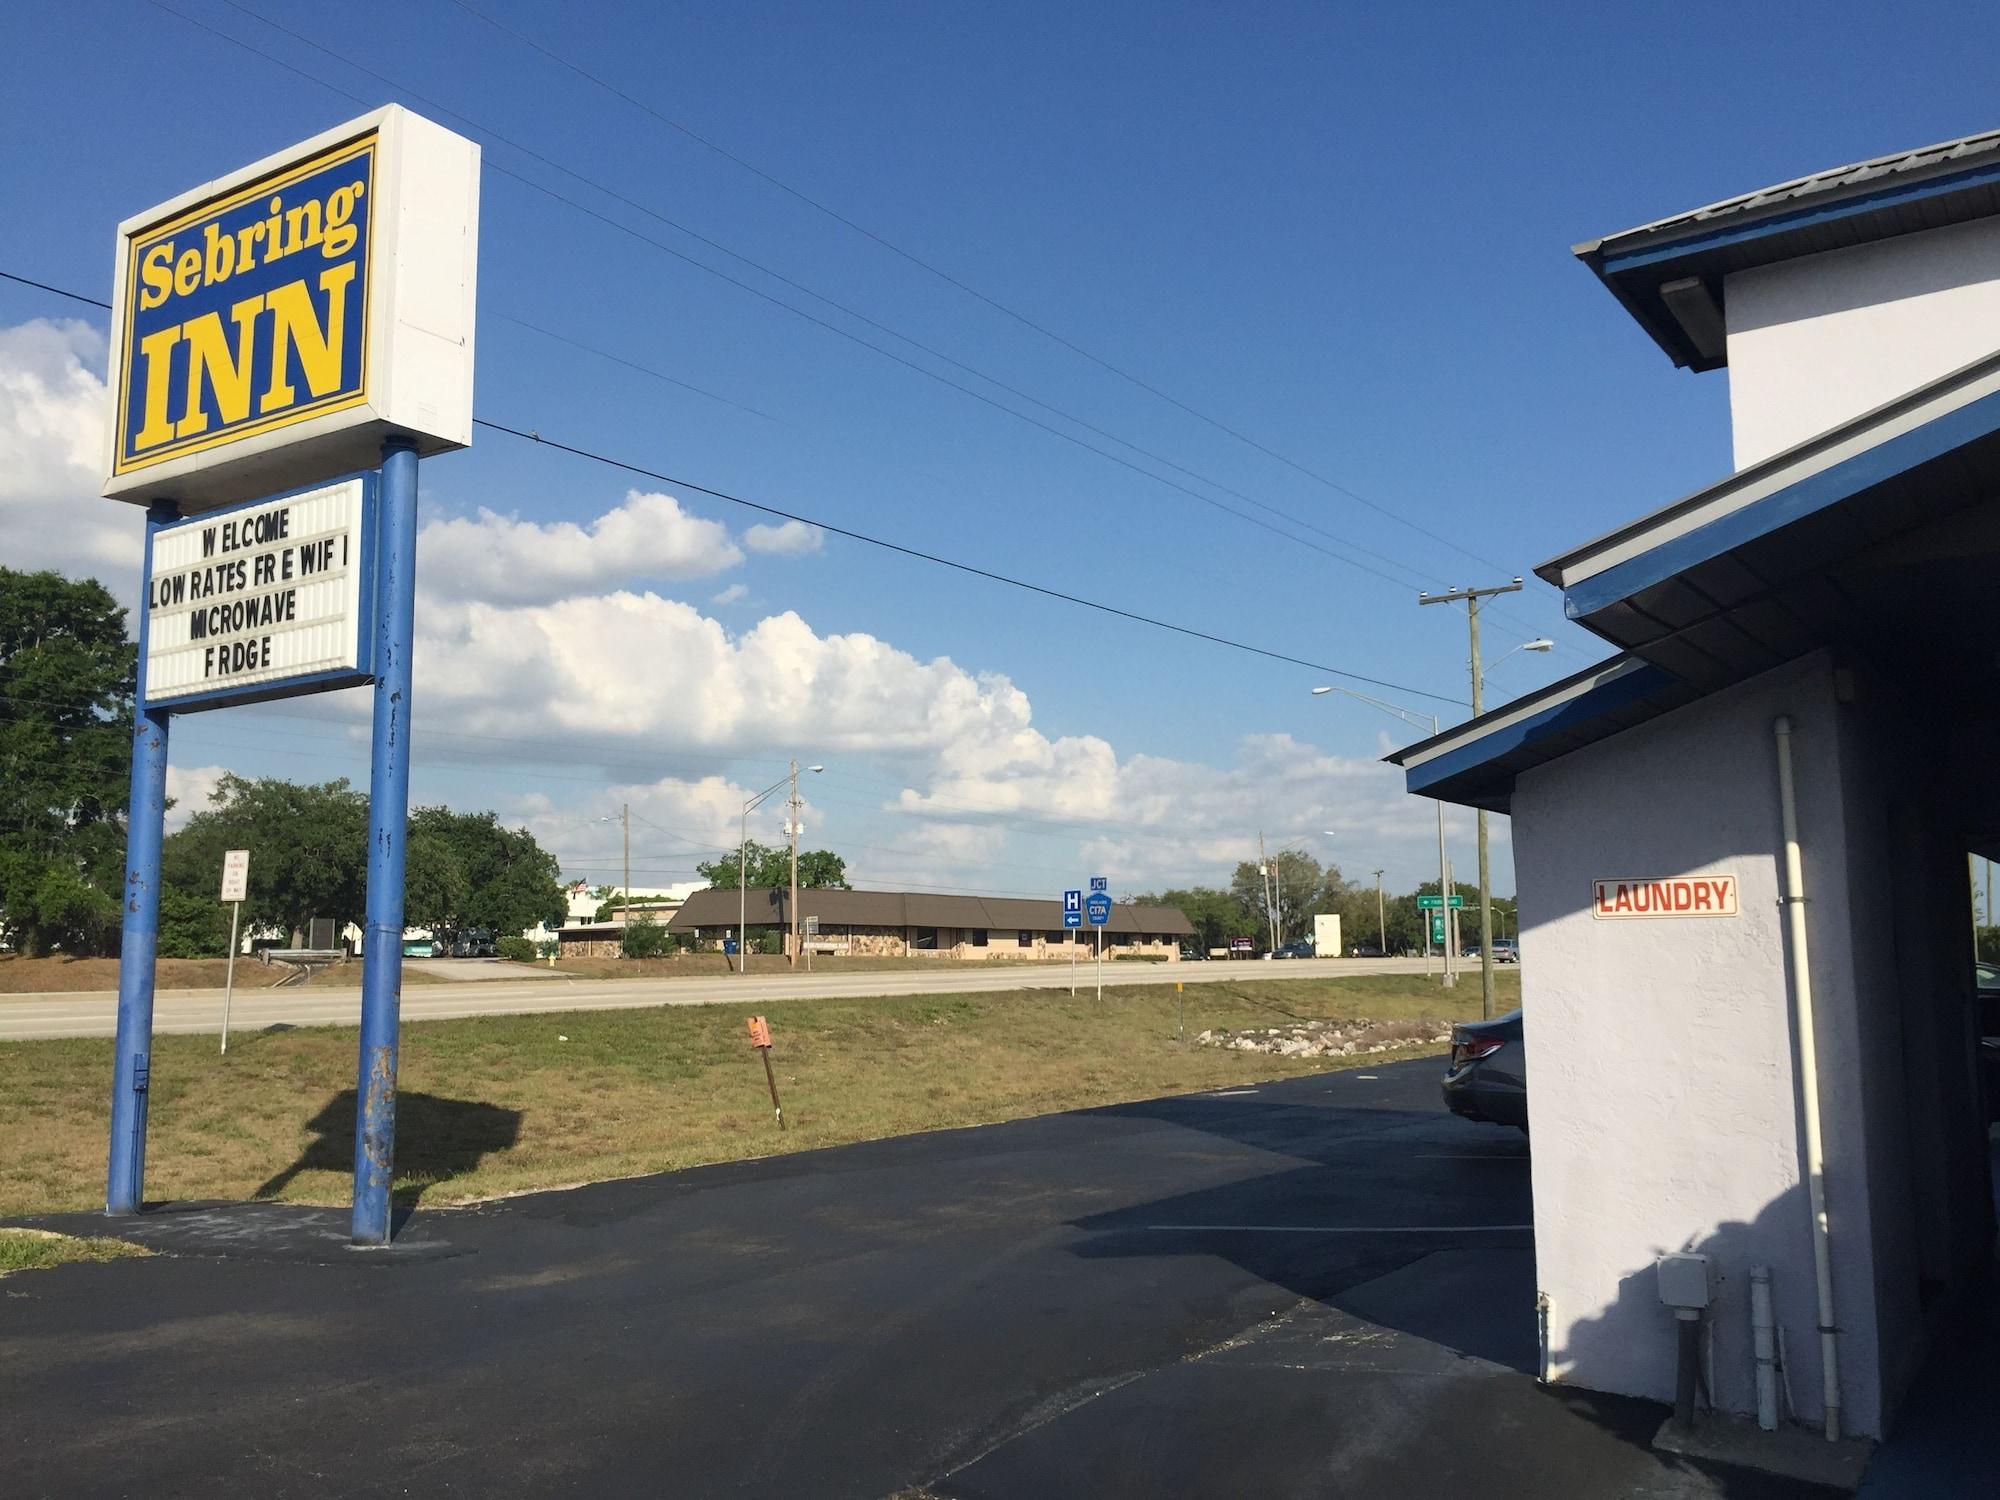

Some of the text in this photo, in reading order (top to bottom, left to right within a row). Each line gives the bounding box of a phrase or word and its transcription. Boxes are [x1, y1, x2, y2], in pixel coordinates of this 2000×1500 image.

[140, 180, 364, 312] Sebring
[135, 260, 356, 453] INN
[150, 573, 186, 609] LOW
[190, 559, 247, 600] RATES
[191, 589, 296, 640] MICROWAVE
[1067, 892, 1079, 910] H
[1091, 879, 1106, 890] JCT
[1599, 881, 1730, 913] LAUNDRY
